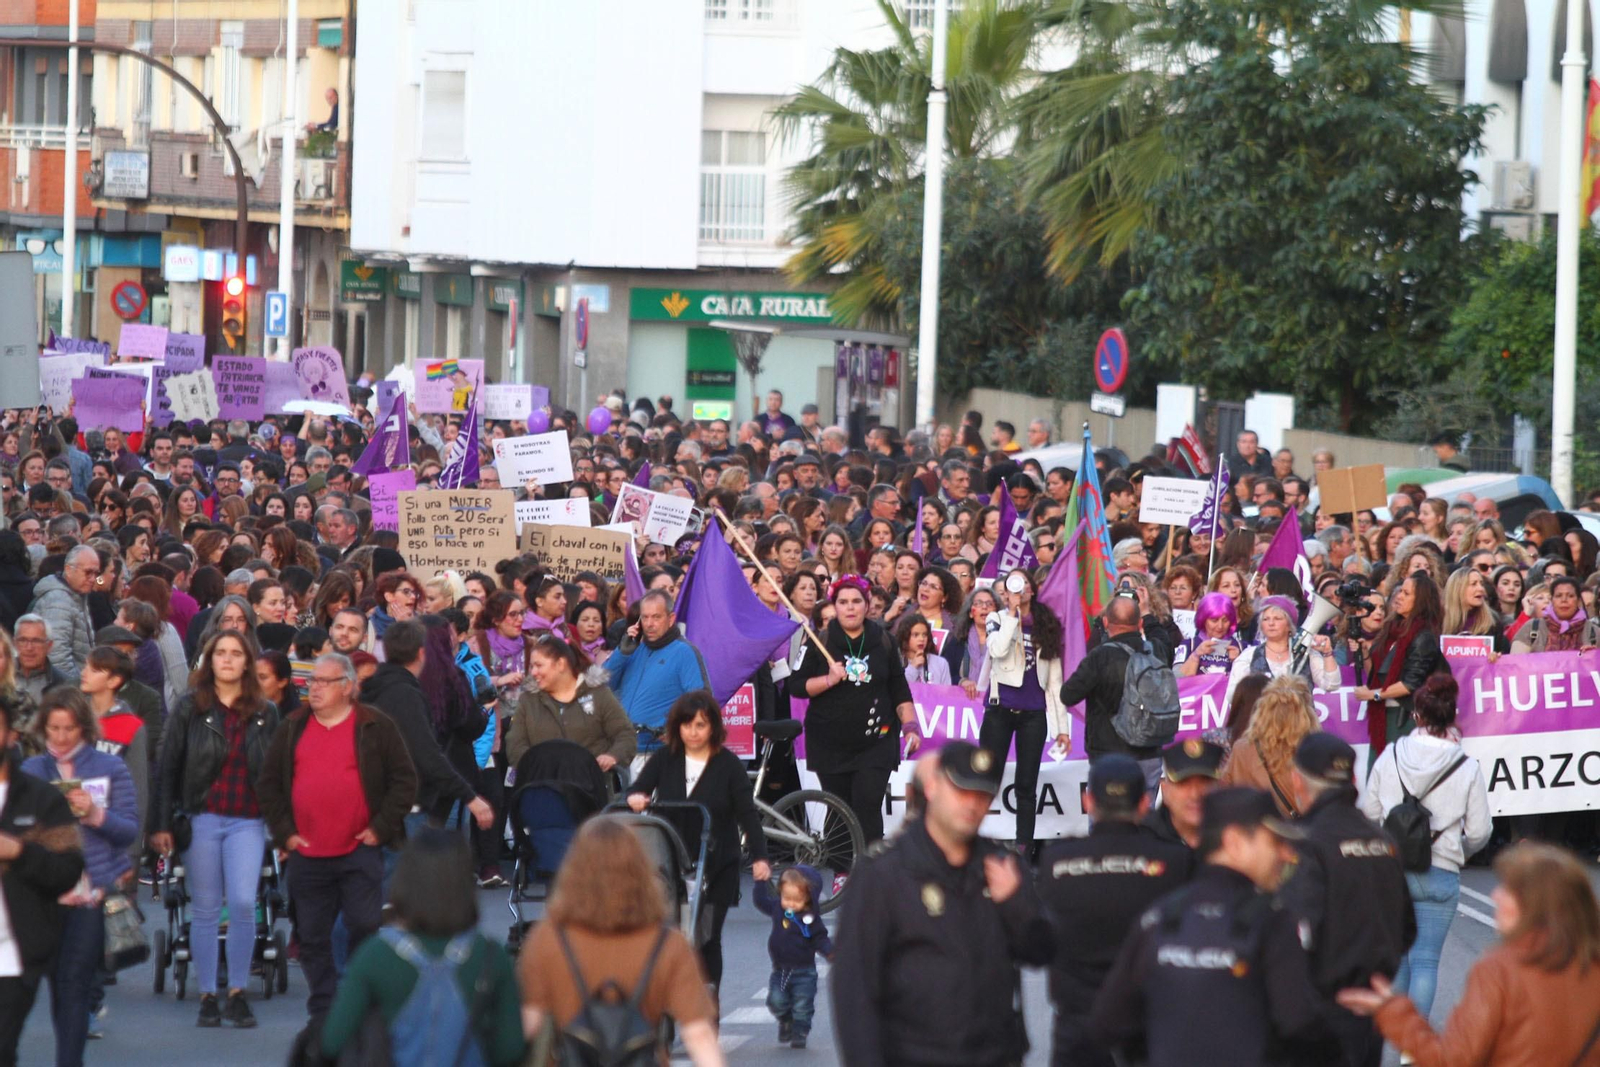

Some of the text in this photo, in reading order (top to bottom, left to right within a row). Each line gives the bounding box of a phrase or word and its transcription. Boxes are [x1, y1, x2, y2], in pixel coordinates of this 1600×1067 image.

[759, 296, 833, 318] RURAL
[269, 297, 283, 332] P
[217, 361, 253, 371] ESTADO
[232, 385, 260, 394] VAMOS
[520, 440, 551, 448] NOSOTRAS
[405, 496, 418, 510] Si
[424, 500, 441, 509] una
[449, 496, 492, 508] MUJER
[431, 514, 449, 522] con
[454, 509, 474, 523] 20
[459, 527, 485, 540] pero
[408, 540, 428, 549] eso
[434, 537, 443, 547] lo
[445, 539, 468, 549] hace
[530, 531, 622, 553] El chaval con la
[477, 556, 487, 568] la
[557, 554, 569, 565] de
[575, 556, 605, 570] perfil
[608, 561, 623, 570] sin
[1446, 646, 1488, 657] APUNTA
[725, 705, 738, 716] MI
[1486, 750, 1600, 793] ARZO
[1052, 854, 1146, 879] POLICIA
[1157, 945, 1236, 969] POLICIA
